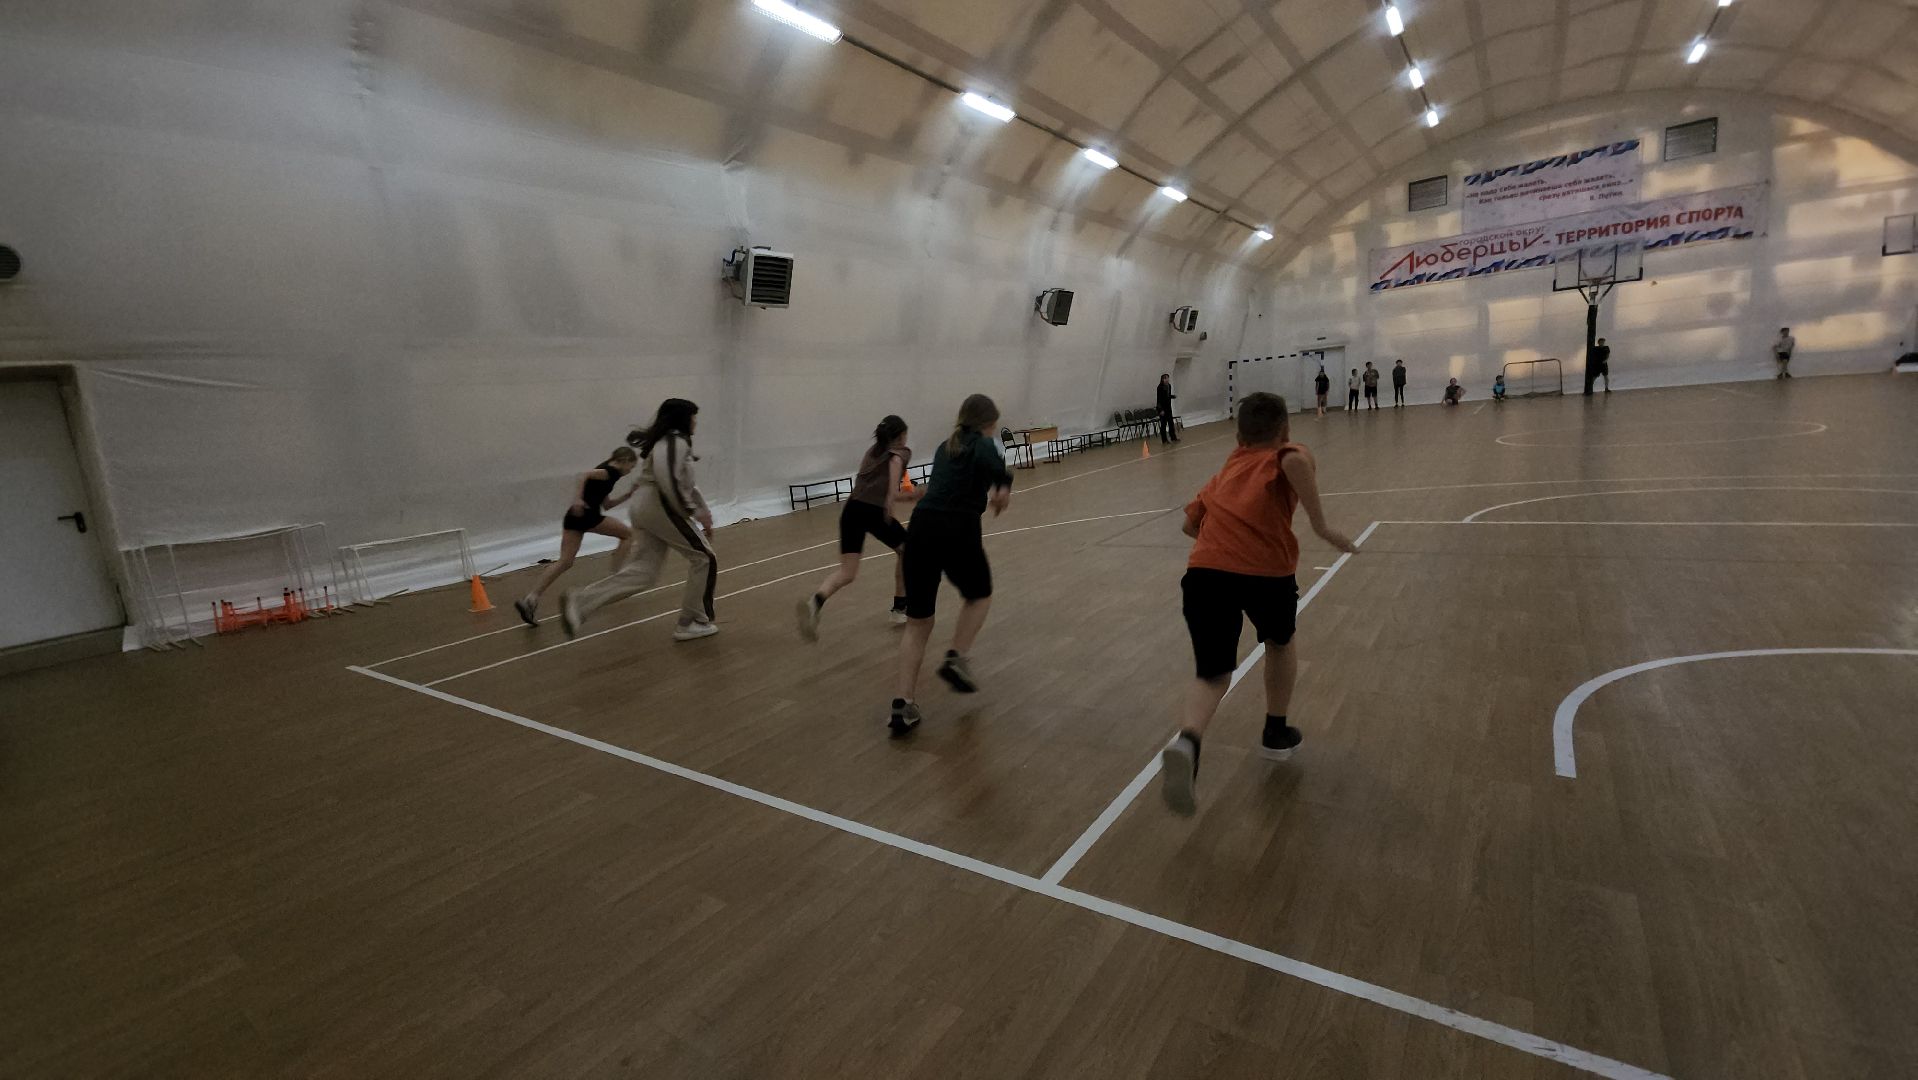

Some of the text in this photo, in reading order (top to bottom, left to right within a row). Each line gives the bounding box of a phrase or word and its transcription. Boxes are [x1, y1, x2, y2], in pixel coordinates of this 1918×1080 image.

[1379, 233, 1544, 280] Люберцы
[1555, 215, 1670, 245] ТЕРРИТОРИЯ
[1675, 206, 1744, 226] СПОРТА
[1458, 225, 1547, 246] городской округ
